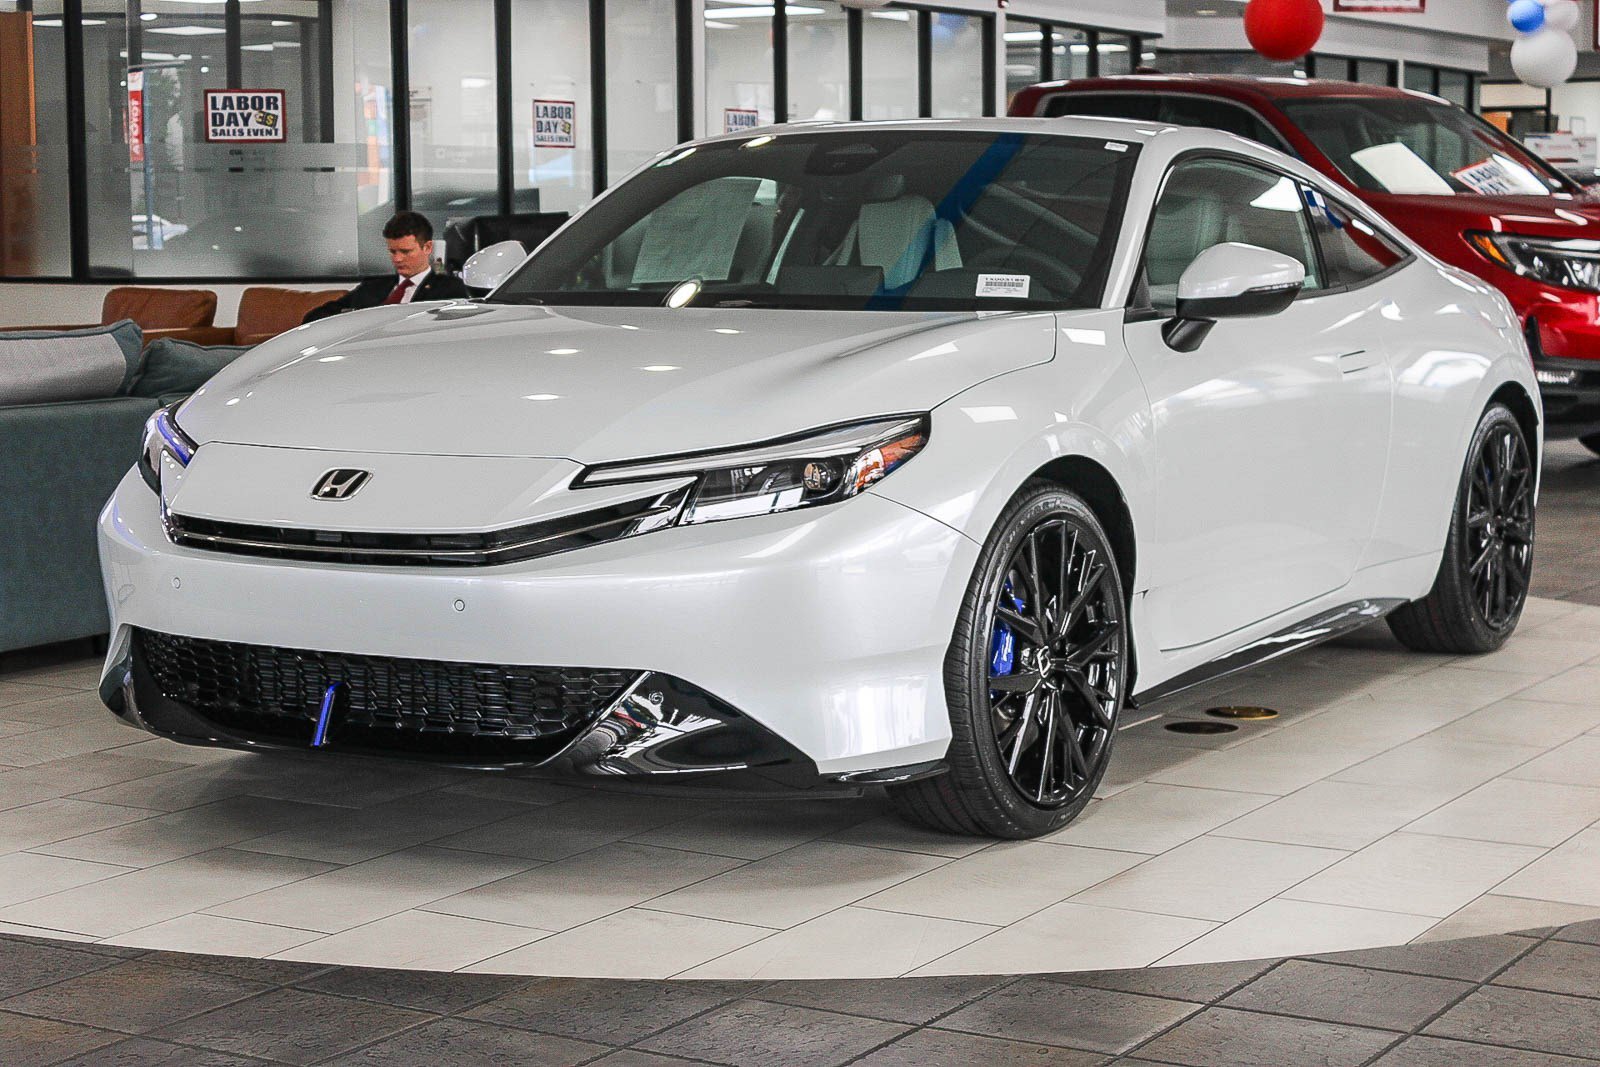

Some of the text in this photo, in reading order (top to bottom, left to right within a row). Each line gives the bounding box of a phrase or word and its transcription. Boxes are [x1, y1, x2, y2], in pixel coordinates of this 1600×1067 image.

[211, 96, 279, 110] LABOR
[211, 112, 252, 126] DAY
[536, 106, 571, 119] LABOR
[727, 114, 755, 126] LABOR
[536, 121, 558, 133] DAY
